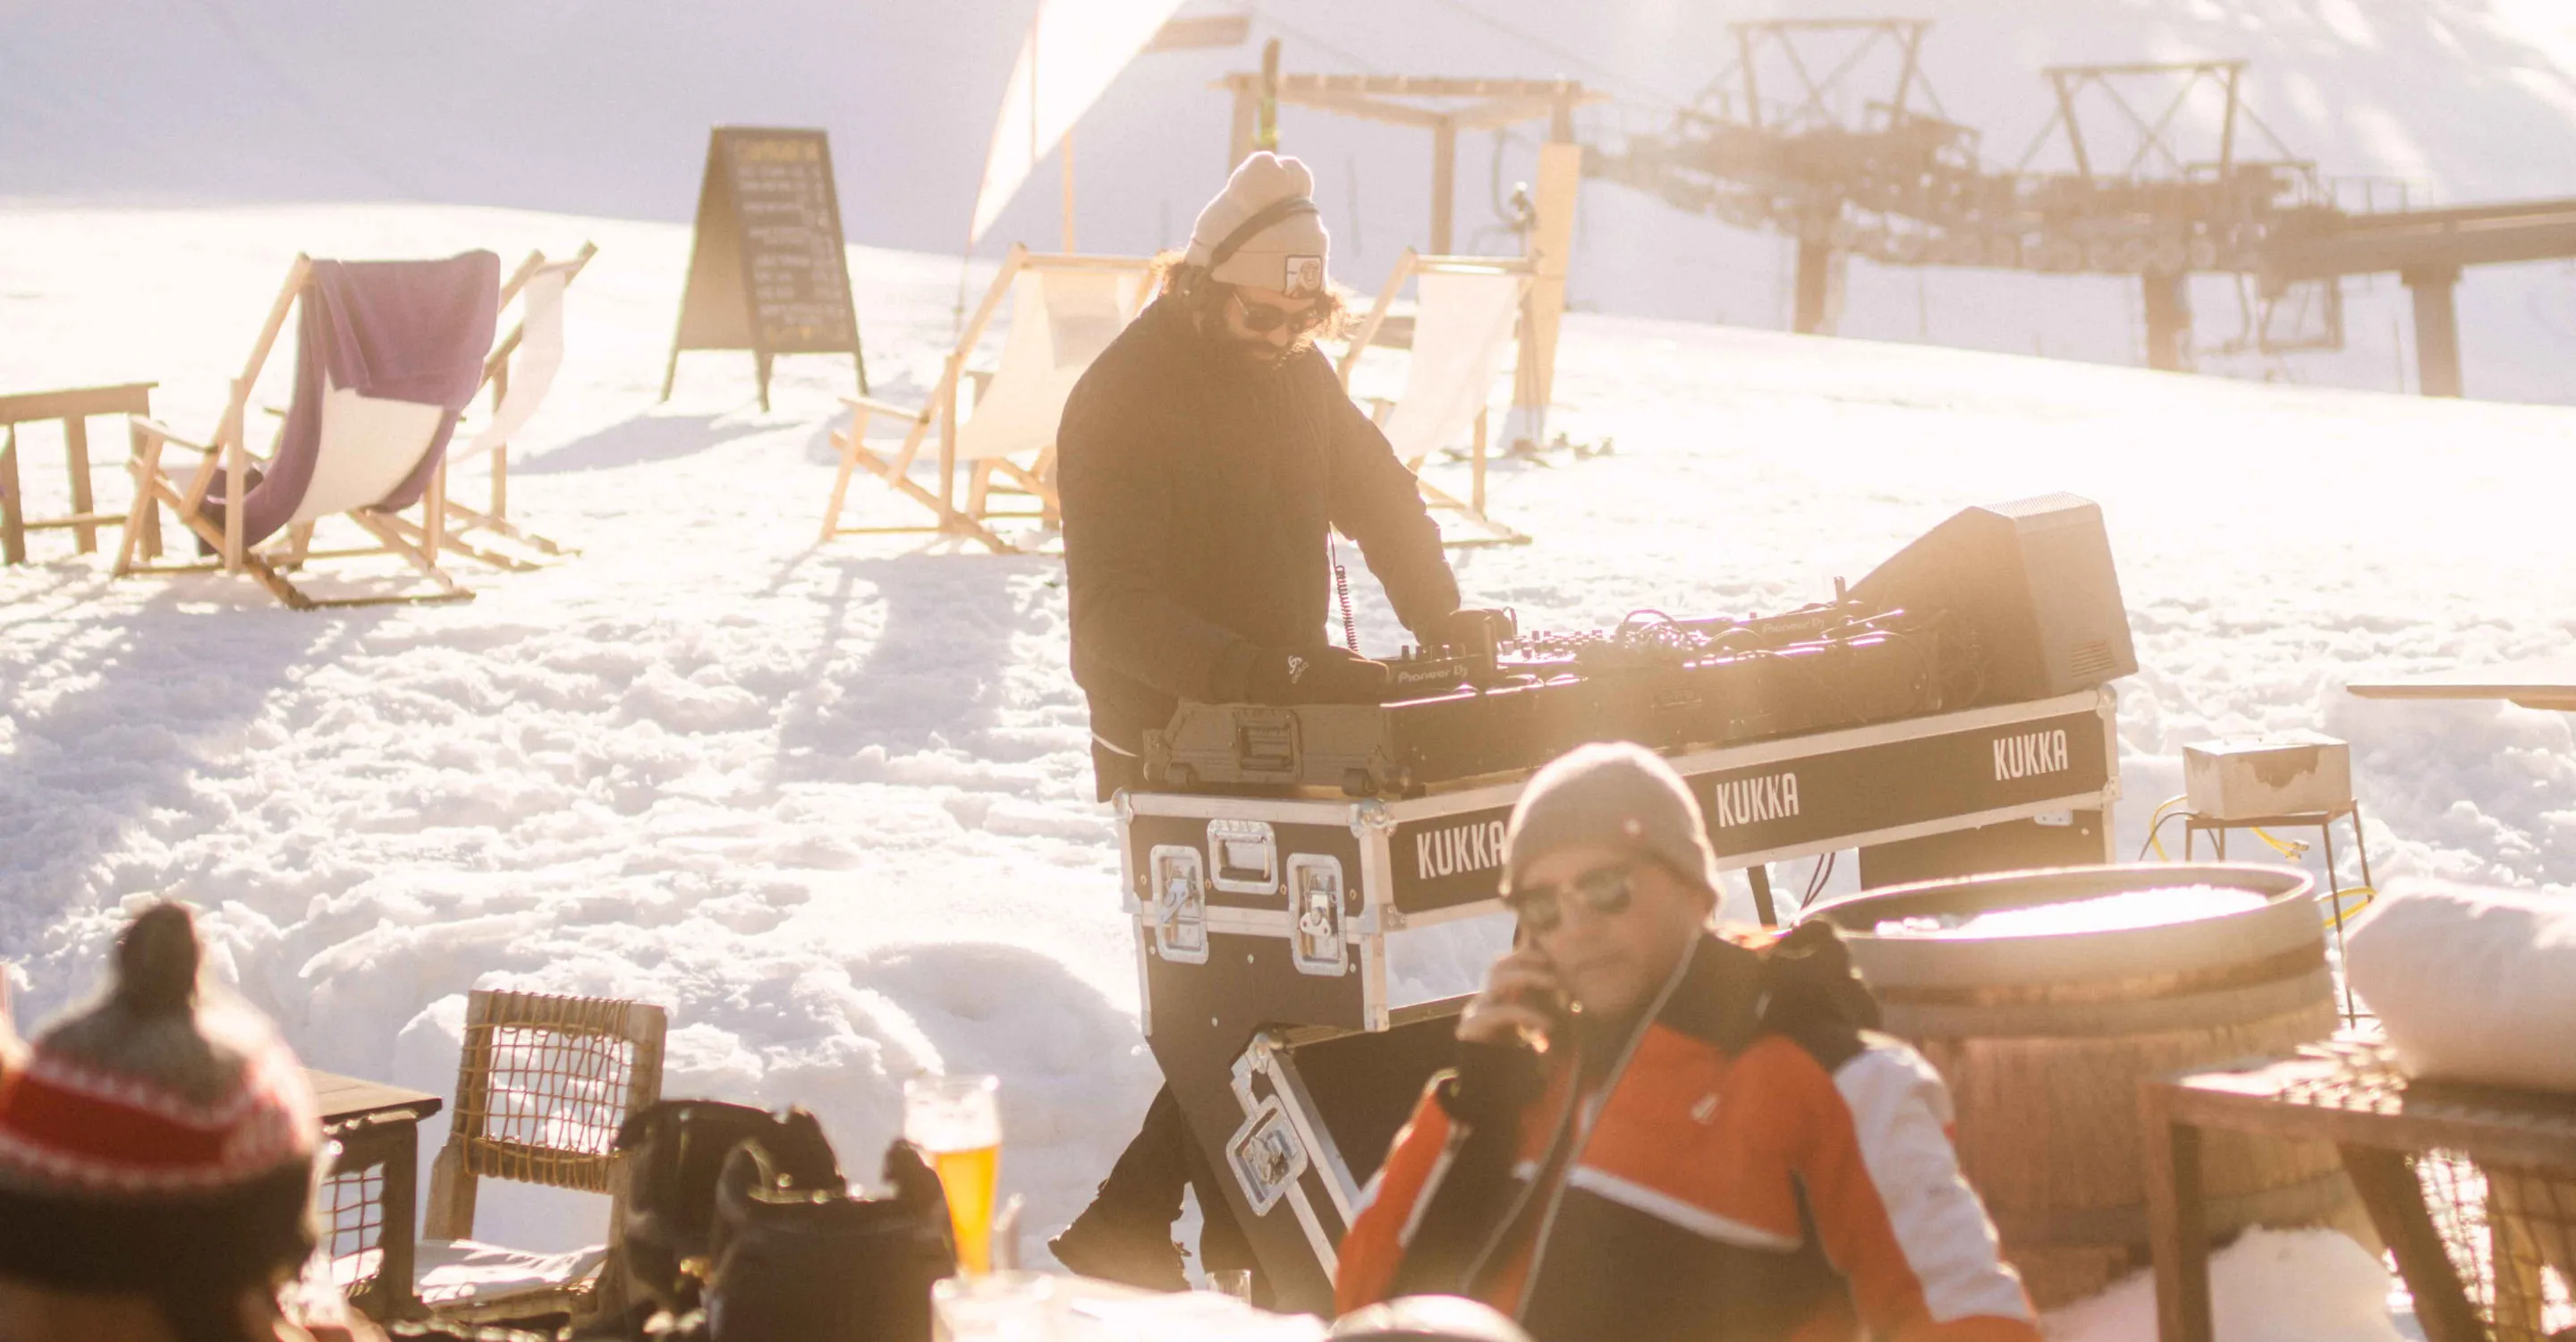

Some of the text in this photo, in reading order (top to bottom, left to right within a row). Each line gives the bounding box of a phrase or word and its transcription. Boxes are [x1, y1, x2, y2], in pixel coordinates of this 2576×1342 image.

[1398, 669, 1451, 684] Pioneer
[1993, 729, 2068, 781] KUKKA
[1716, 772, 1799, 828] KUKKA
[1416, 820, 1506, 879] KUKKA
